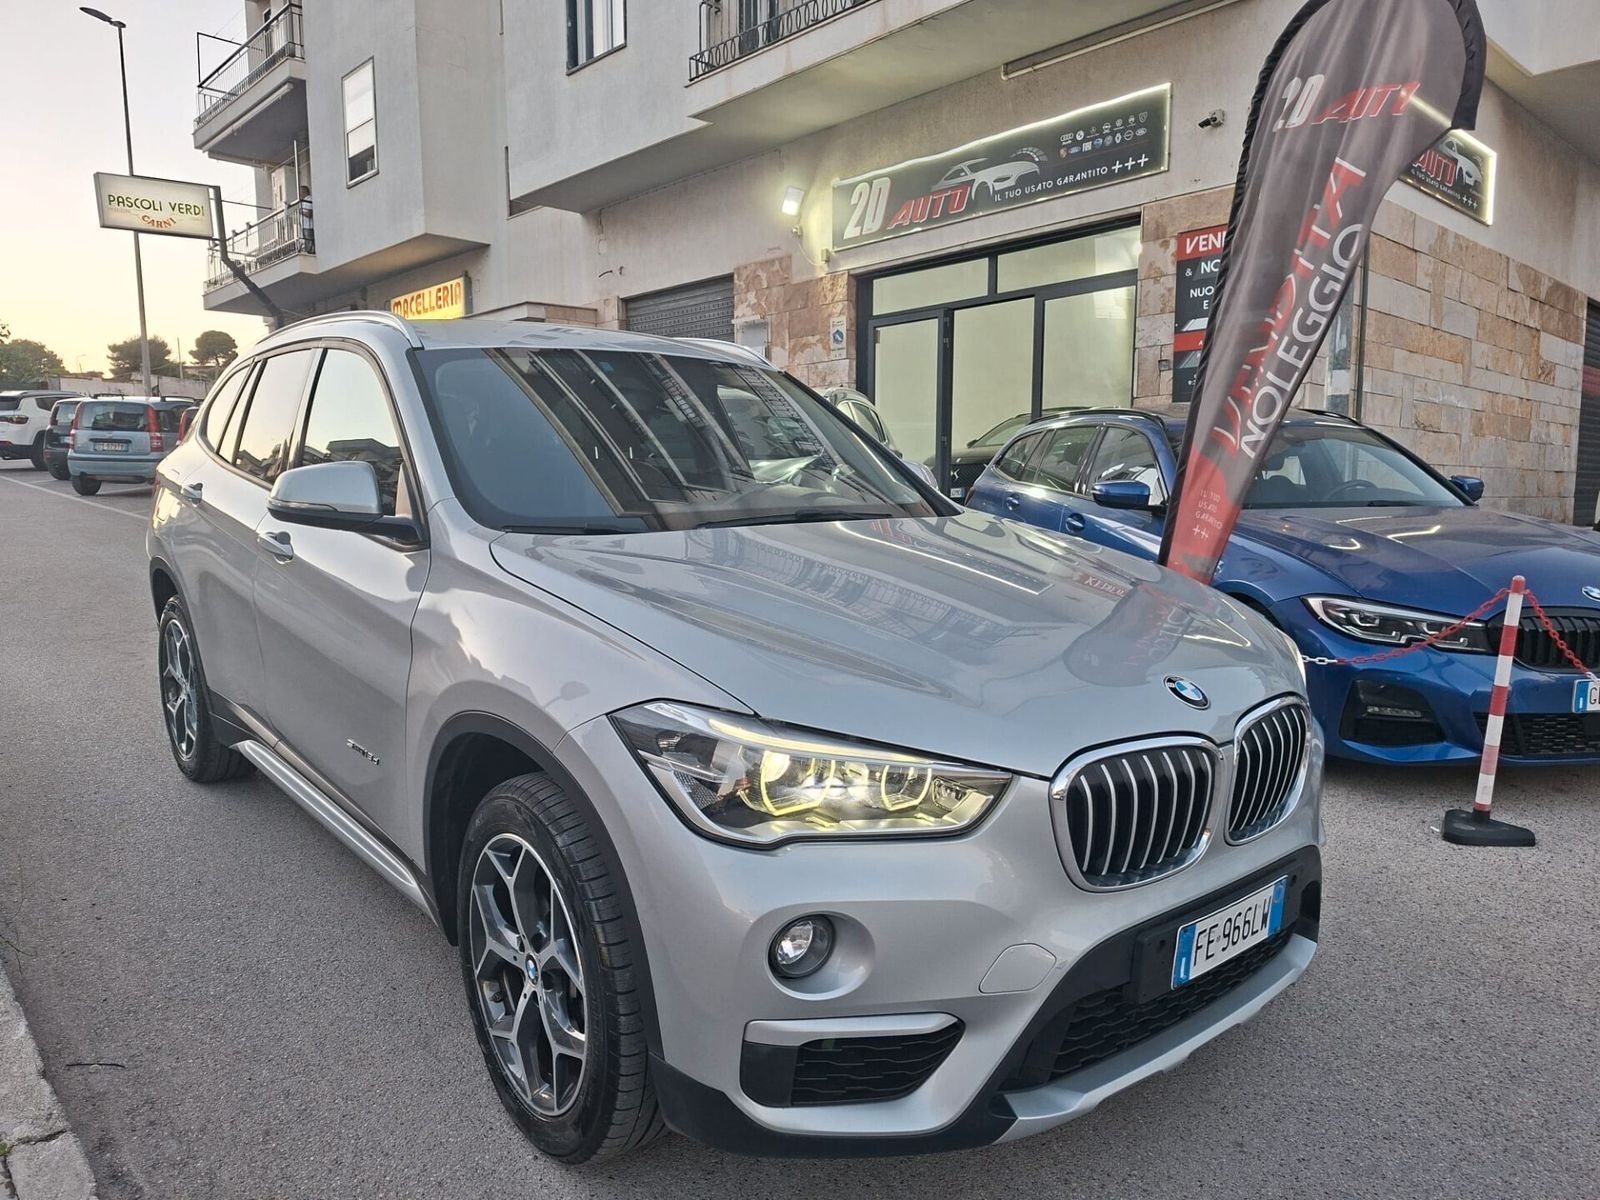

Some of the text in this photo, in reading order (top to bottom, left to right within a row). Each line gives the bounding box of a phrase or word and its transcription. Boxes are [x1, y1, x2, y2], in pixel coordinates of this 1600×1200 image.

[994, 194, 1002, 202] IL
[1004, 188, 1022, 199] TUO
[1024, 180, 1053, 194] USATO
[1056, 166, 1108, 186] GARANTITO
[108, 194, 163, 212] PASCOLI
[168, 201, 205, 217] VERDI
[141, 214, 177, 228] CARNI
[886, 184, 972, 230] AUTO
[393, 281, 462, 318] MACELLERIA
[1240, 224, 1364, 459] NOLEGGIO
